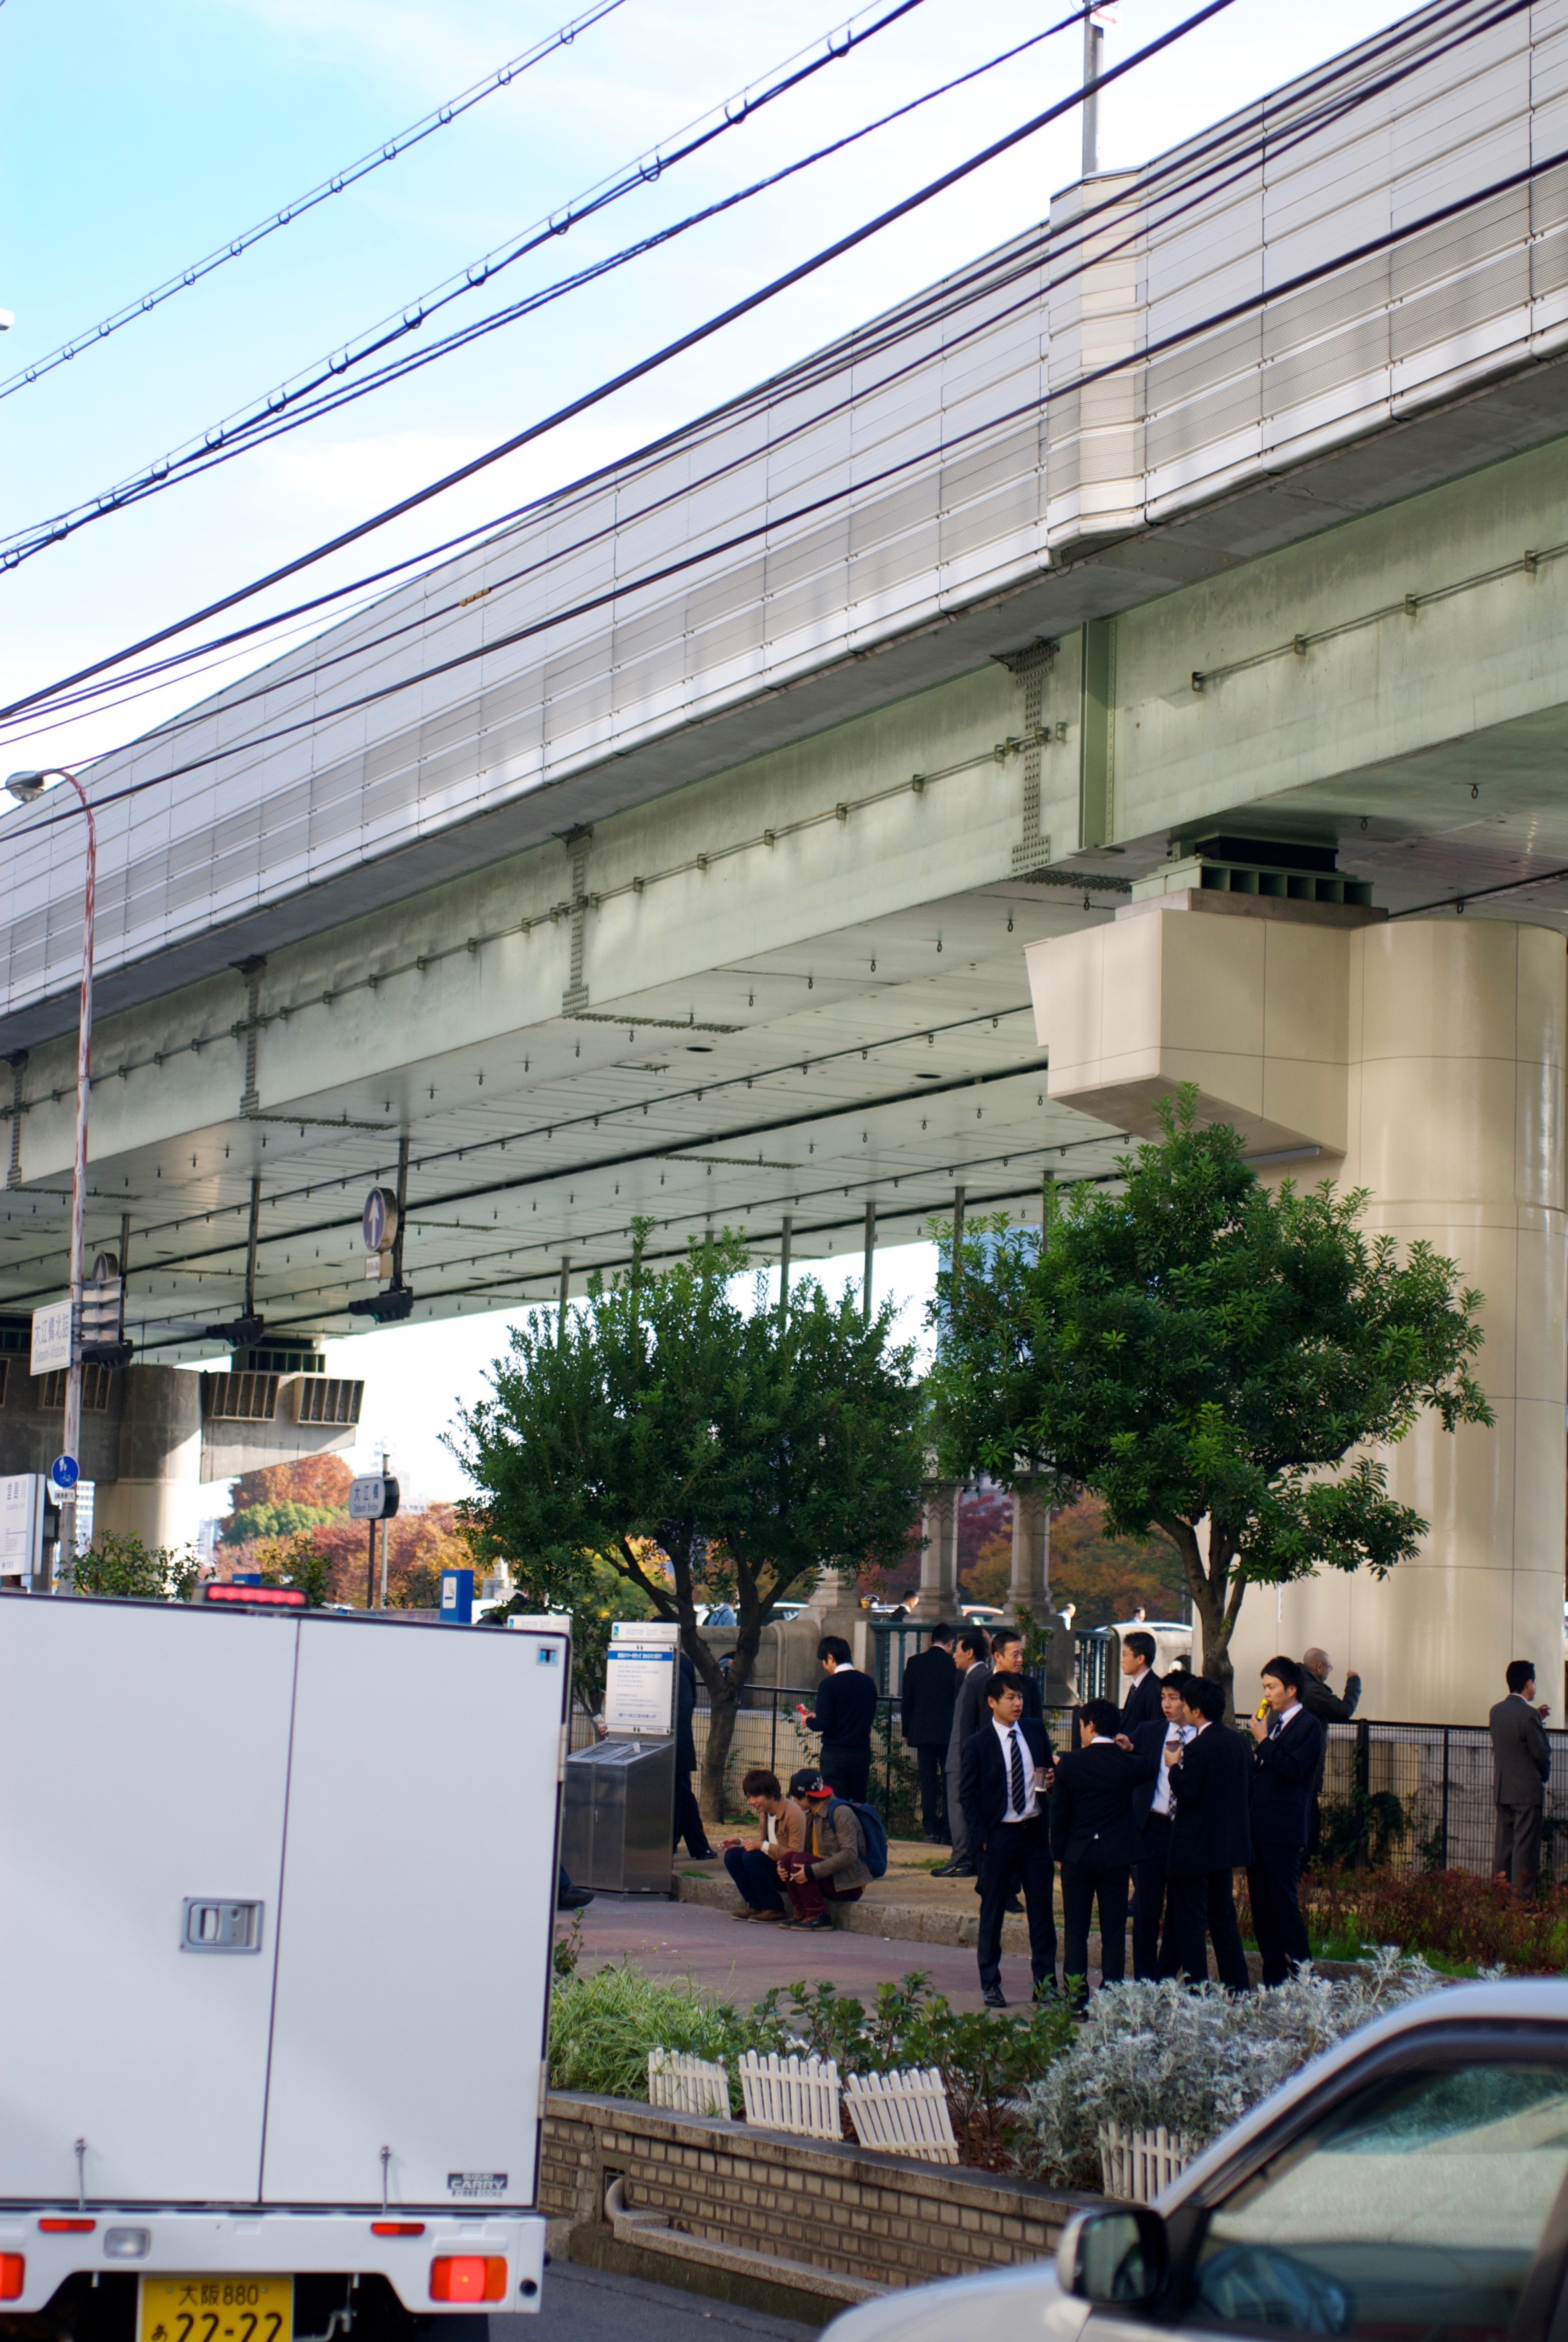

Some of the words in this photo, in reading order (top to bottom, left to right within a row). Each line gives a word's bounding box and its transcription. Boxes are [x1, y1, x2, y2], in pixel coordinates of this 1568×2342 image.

[540, 1619, 550, 1628] Spot
[626, 1627, 645, 1636] Manner
[646, 1627, 657, 1638] Spot
[451, 2179, 505, 2189] CARRY
